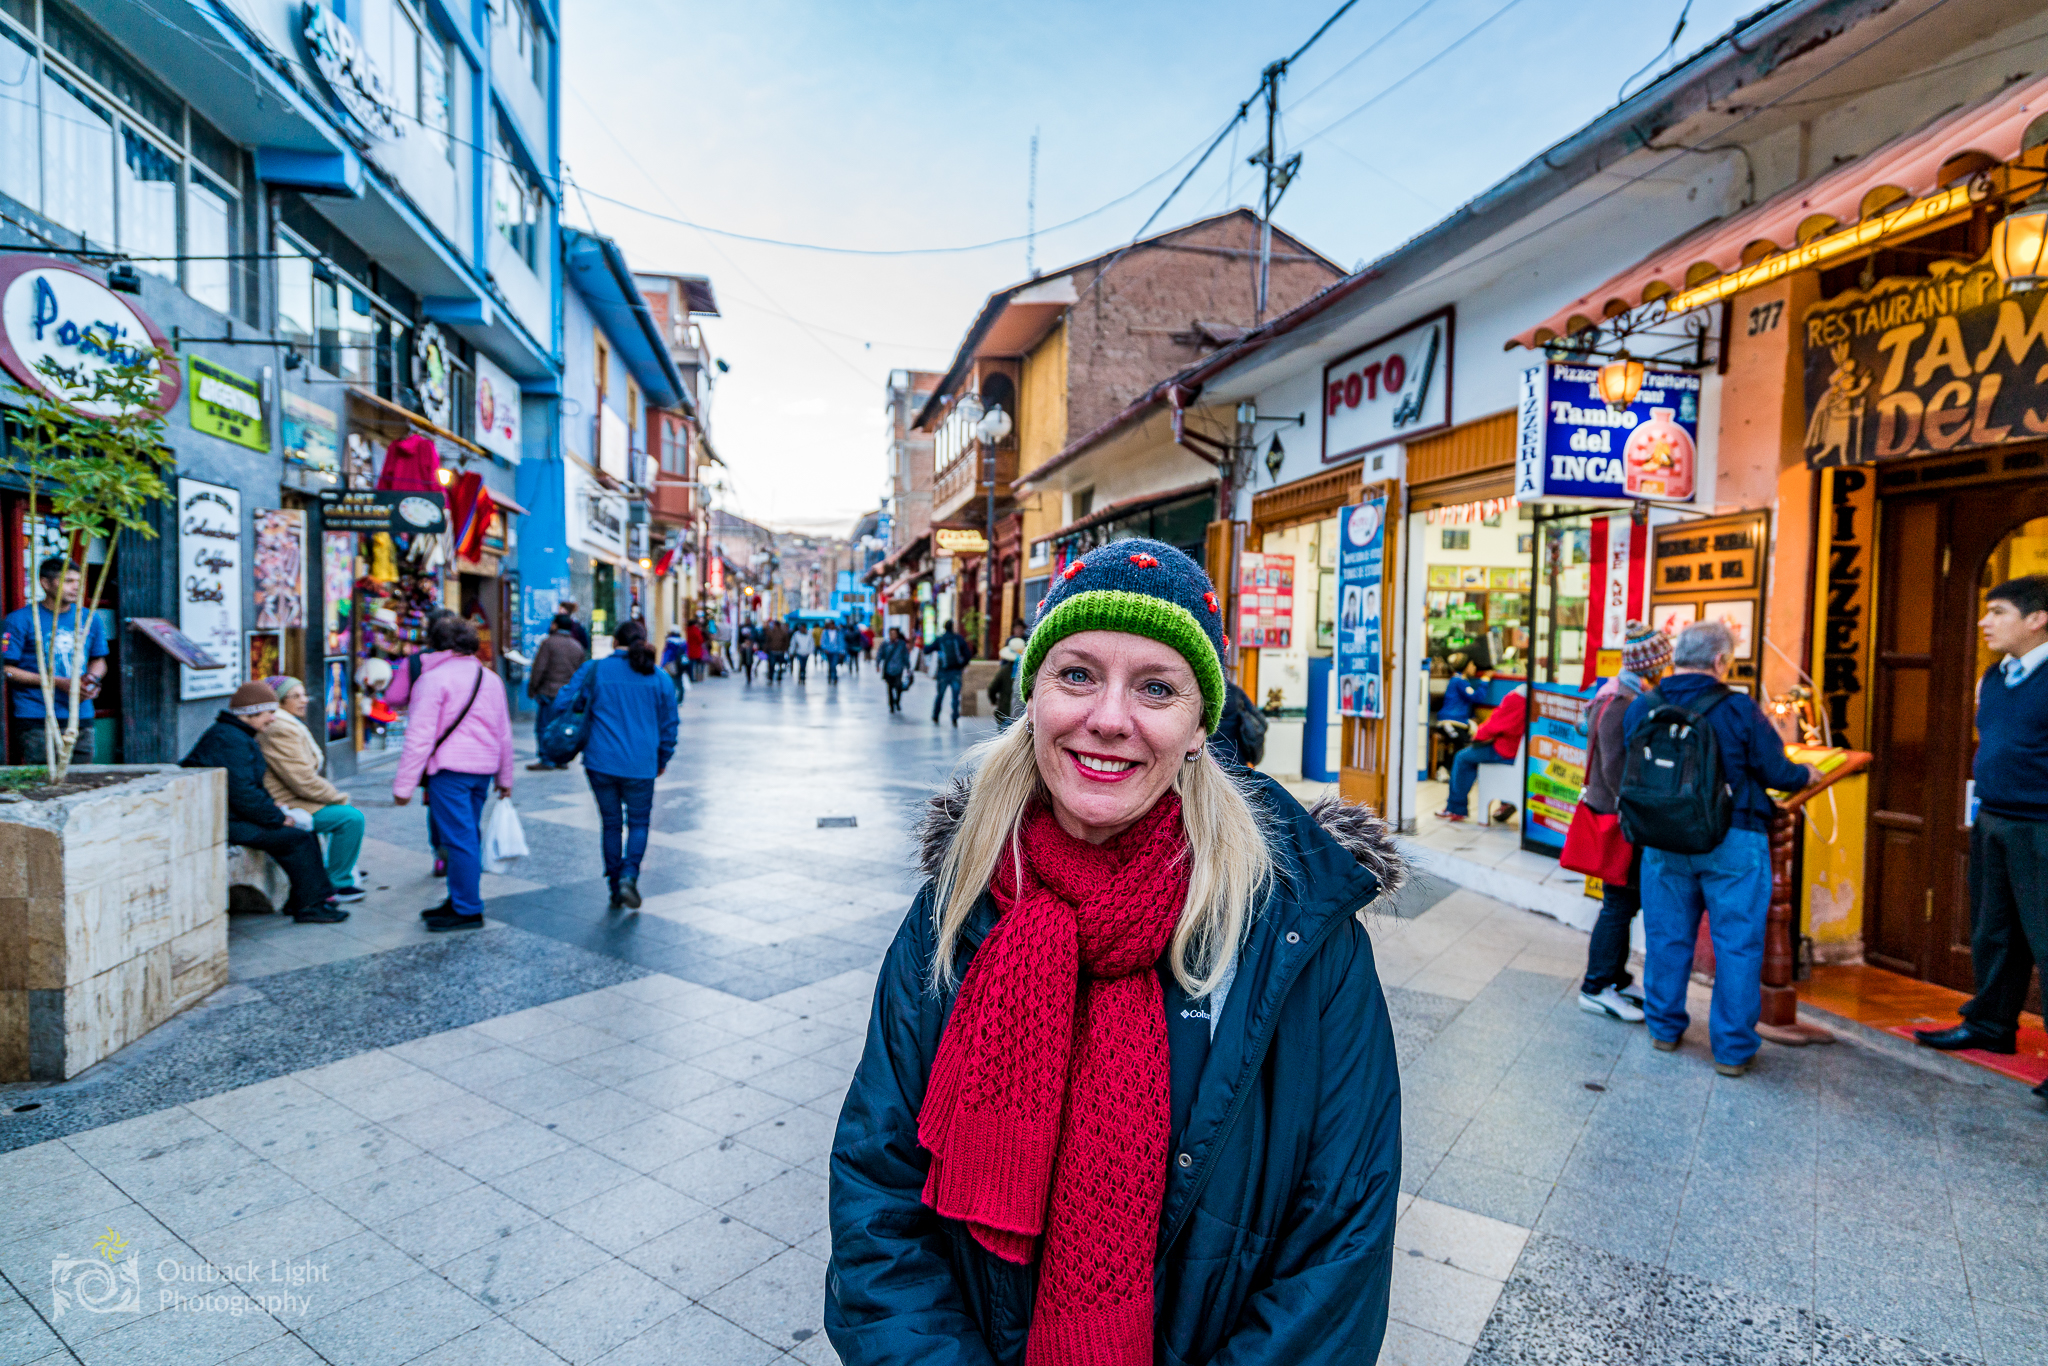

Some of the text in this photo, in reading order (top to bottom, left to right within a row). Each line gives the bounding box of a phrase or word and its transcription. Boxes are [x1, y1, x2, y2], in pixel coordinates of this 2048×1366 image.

[1748, 299, 1785, 337] 377
[1808, 279, 1964, 349] RESTAURANT
[1327, 353, 1406, 417] FOTO
[1520, 367, 1540, 493] PIZZERIA
[1551, 400, 1639, 430] Tambo
[1570, 427, 1611, 453] del
[1550, 454, 1628, 484] INCA
[342, 492, 376, 505] ART
